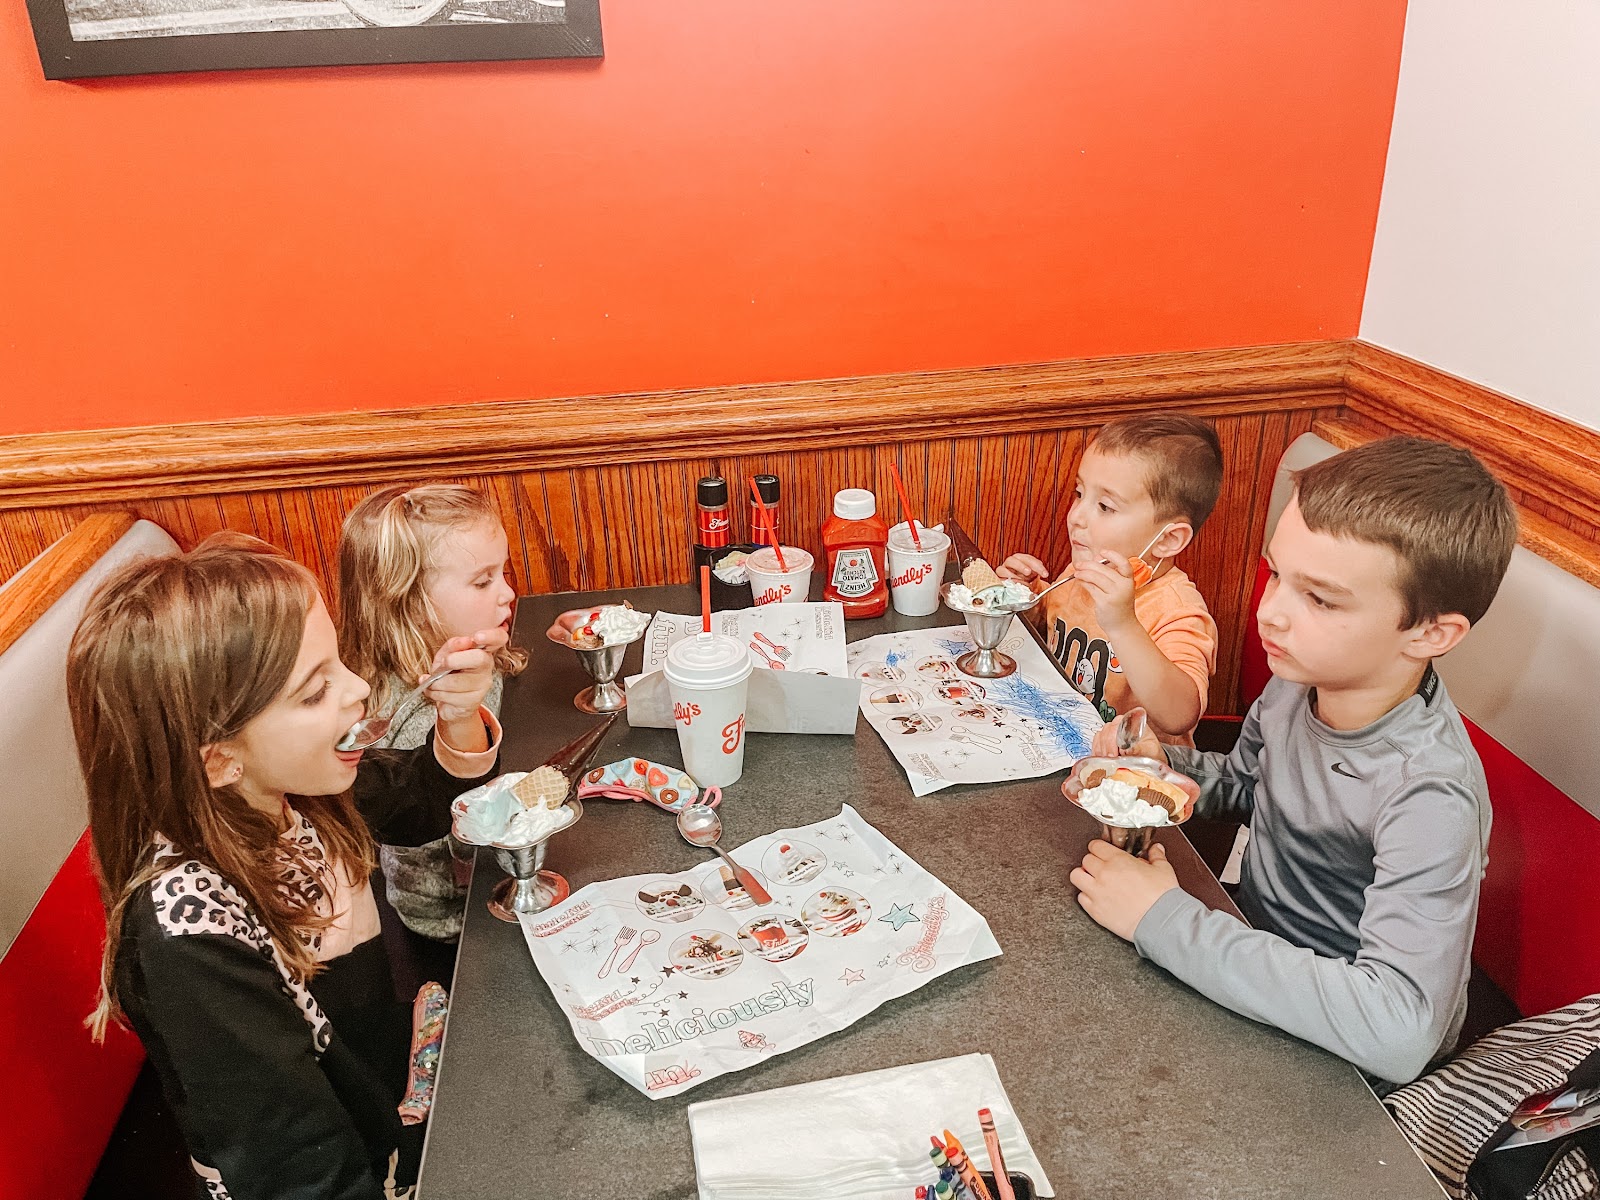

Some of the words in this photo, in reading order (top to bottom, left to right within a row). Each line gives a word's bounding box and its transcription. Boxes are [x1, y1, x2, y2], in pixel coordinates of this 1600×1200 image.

[845, 582, 866, 591] HEINZ
[891, 563, 933, 588] endly's
[586, 977, 814, 1057] Deliciously
